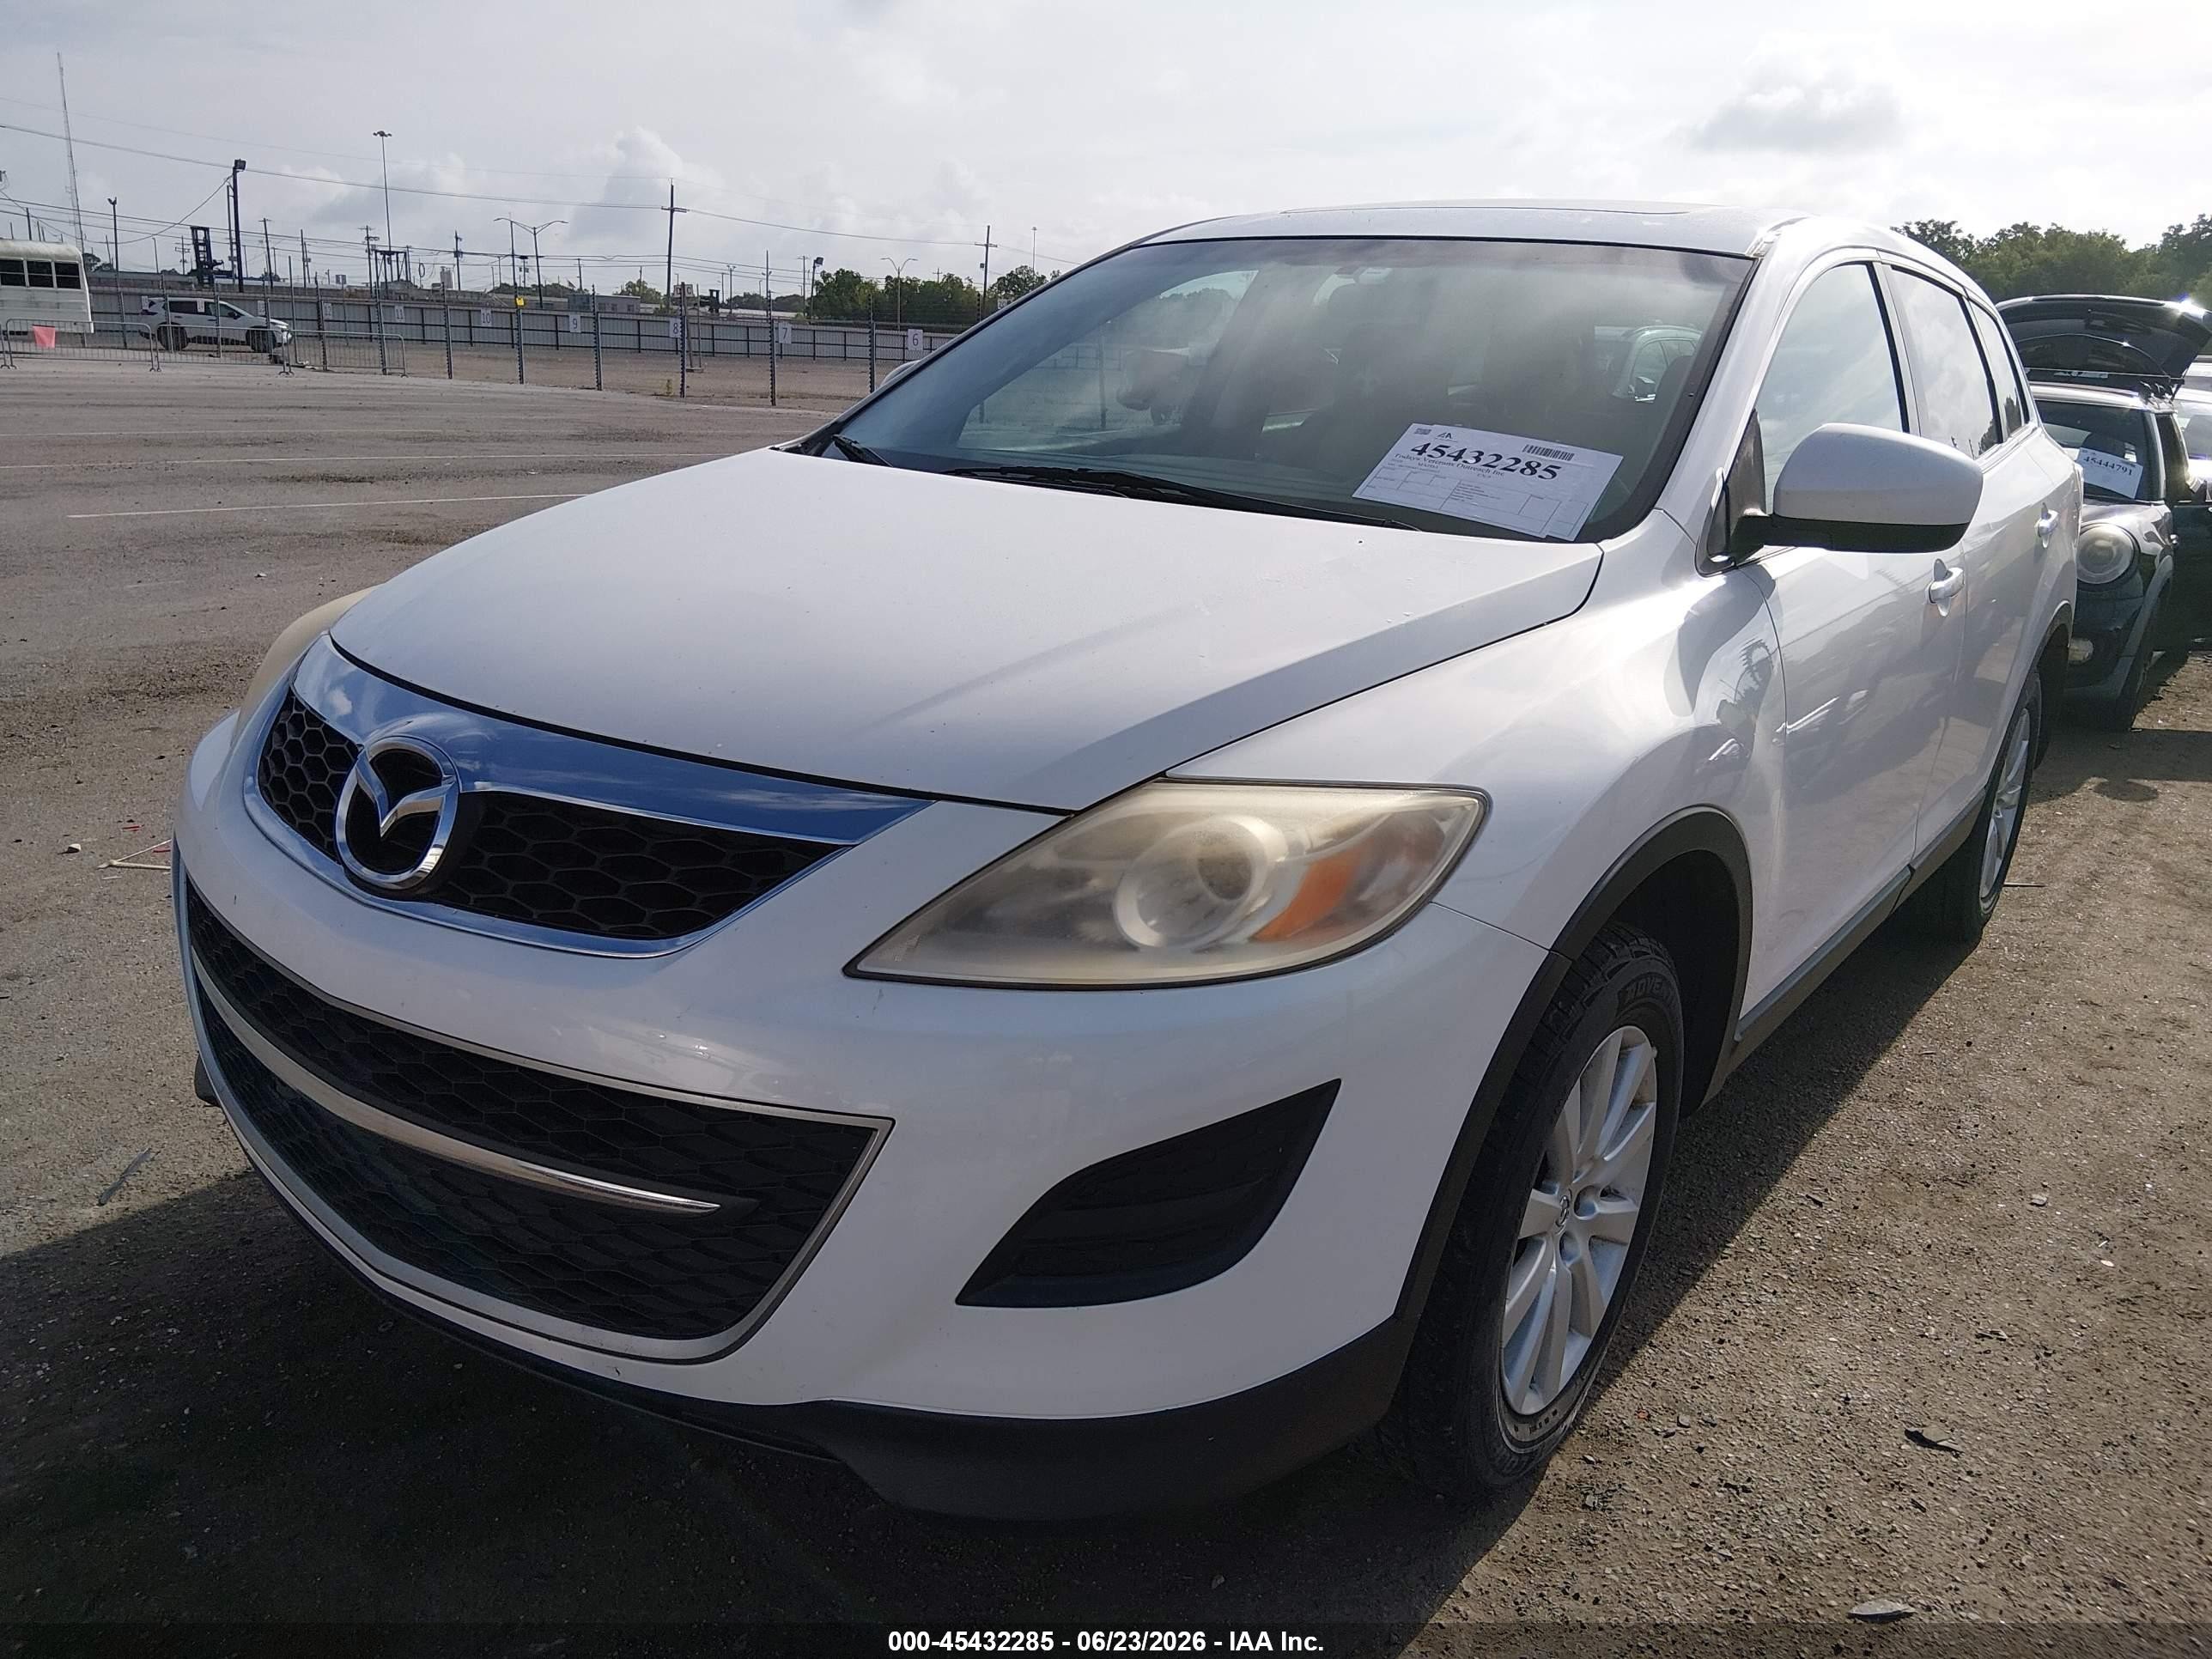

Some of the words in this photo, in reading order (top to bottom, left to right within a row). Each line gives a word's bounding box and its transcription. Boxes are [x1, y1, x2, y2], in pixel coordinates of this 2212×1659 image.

[482, 313, 490, 324] 10
[572, 318, 578, 329] 9
[673, 323, 678, 334] 8
[782, 327, 788, 339] 7
[912, 333, 919, 346] 6
[1411, 442, 1562, 479] 45432285
[2084, 456, 2132, 476] 45444791
[1456, 464, 1491, 474] Outreach
